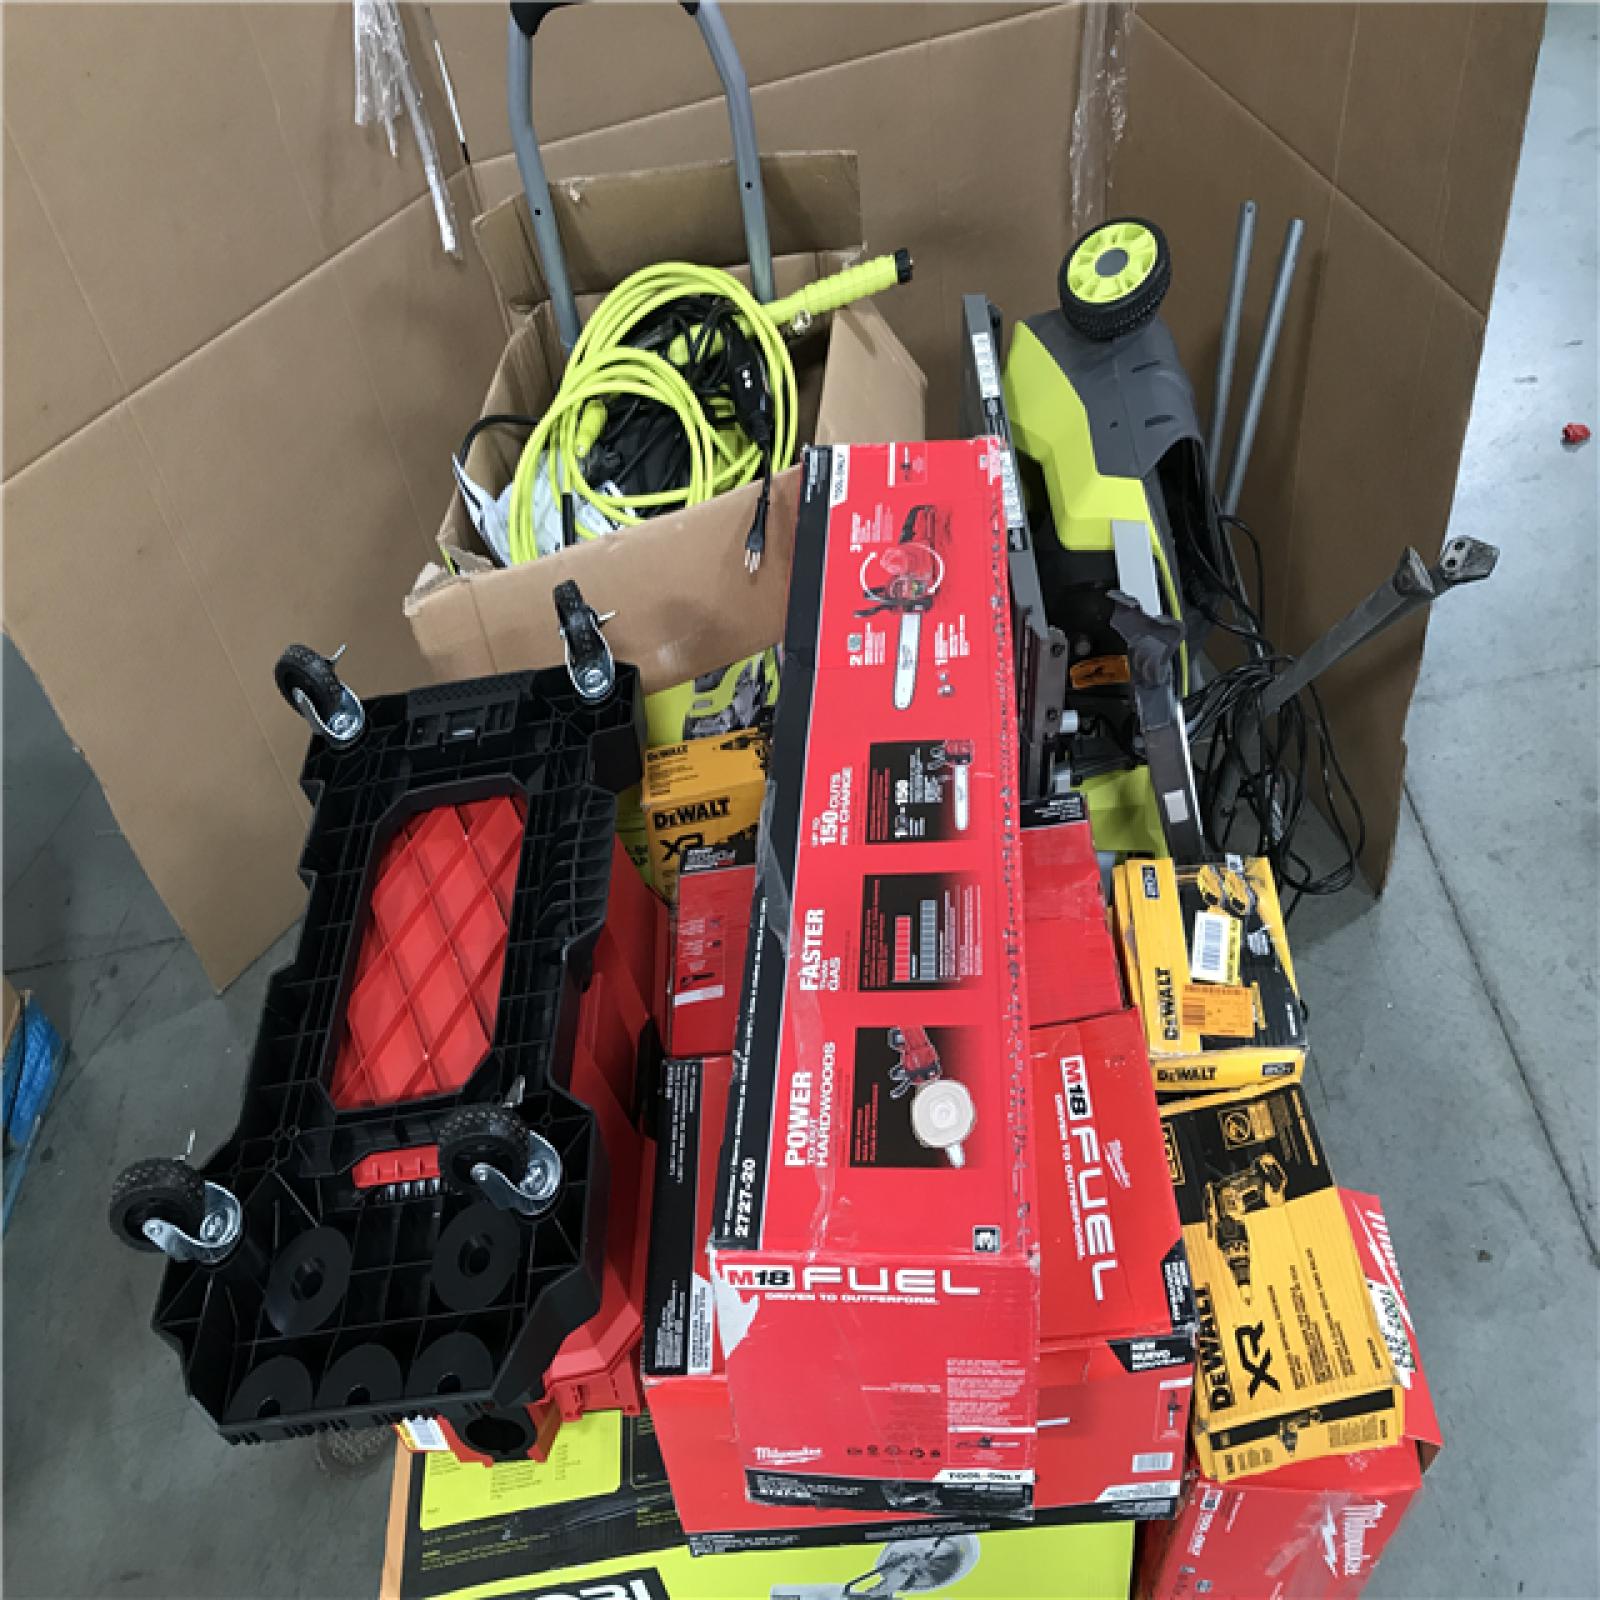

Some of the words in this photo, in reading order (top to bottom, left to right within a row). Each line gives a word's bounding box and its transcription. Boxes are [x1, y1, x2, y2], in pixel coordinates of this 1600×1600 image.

[653, 797, 730, 831] DEWALT
[820, 810, 838, 846] 150
[830, 773, 842, 808] CUTS
[800, 909, 825, 991] FASTER
[830, 957, 841, 991] GAS
[1156, 967, 1180, 1040] DEWALT
[816, 1041, 836, 1168] HARDWOODS
[1064, 1060, 1087, 1115] M18
[1157, 1065, 1217, 1082] DEWALT
[784, 1070, 813, 1166] POWER
[1062, 1144, 1071, 1160] TO
[735, 1158, 757, 1238] 2727-20
[1072, 1126, 1117, 1300] FUEL
[727, 1267, 791, 1287] M18
[803, 1266, 981, 1296] FUEL
[765, 1291, 816, 1301] DRIVEN
[819, 1292, 837, 1302] TO
[1132, 1350, 1171, 1361] NUEVO
[1195, 1283, 1236, 1411] DEWALT
[1235, 1321, 1281, 1400] XR
